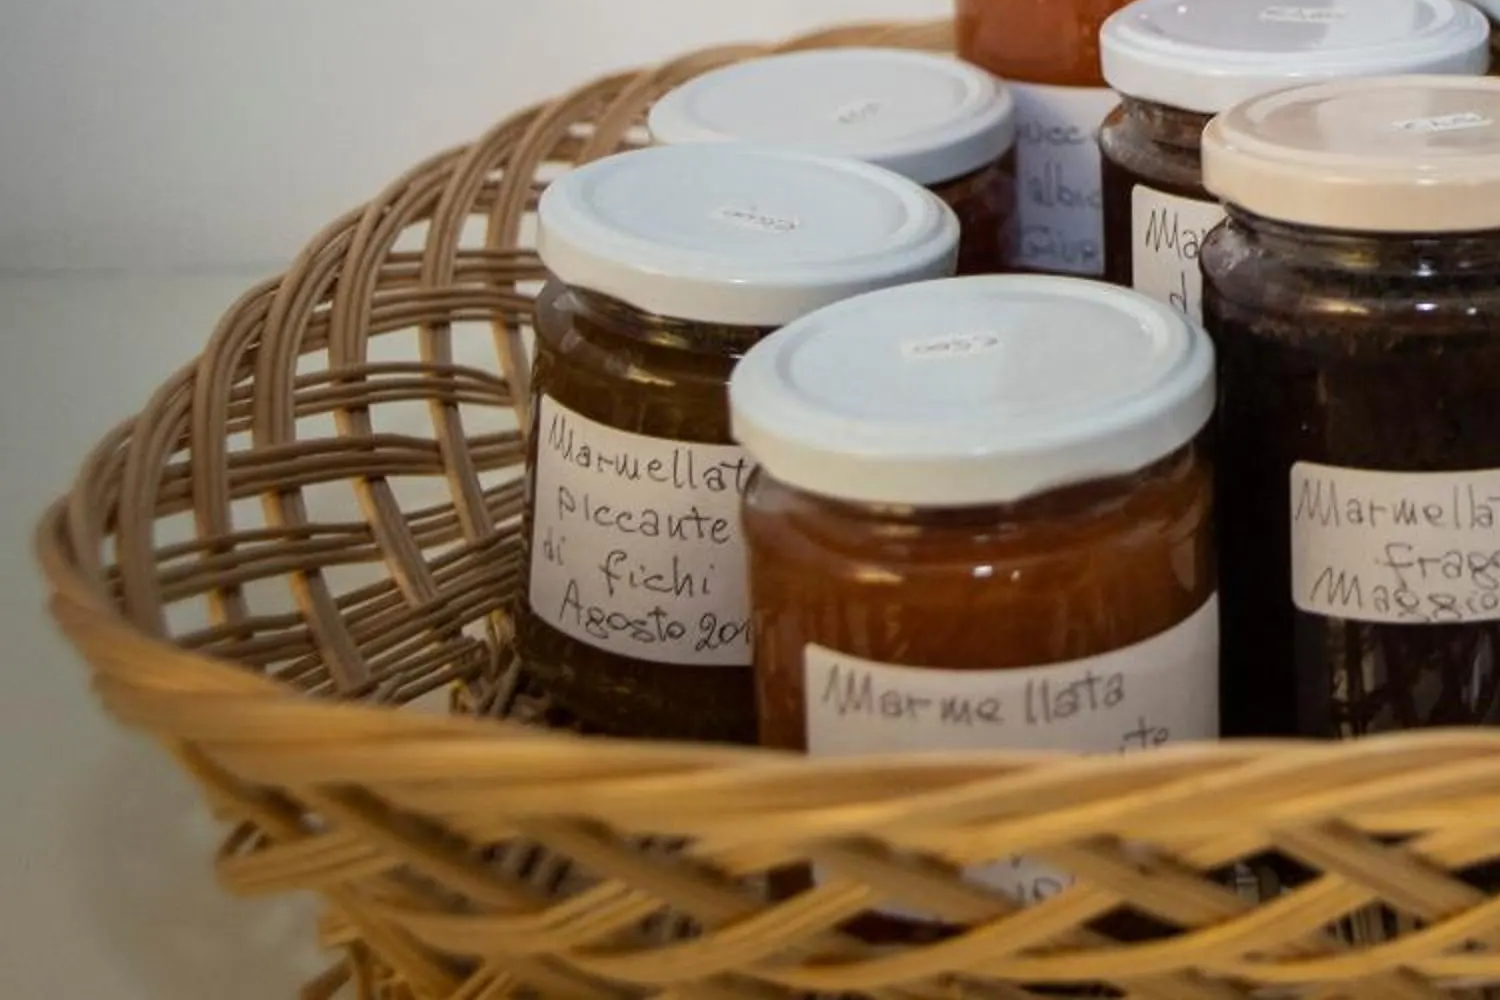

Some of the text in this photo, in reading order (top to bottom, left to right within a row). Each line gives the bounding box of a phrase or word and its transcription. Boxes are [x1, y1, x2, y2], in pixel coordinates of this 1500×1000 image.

[548, 411, 749, 493] Marmellat
[599, 550, 716, 599] fichi
[558, 578, 687, 643] Agosto
